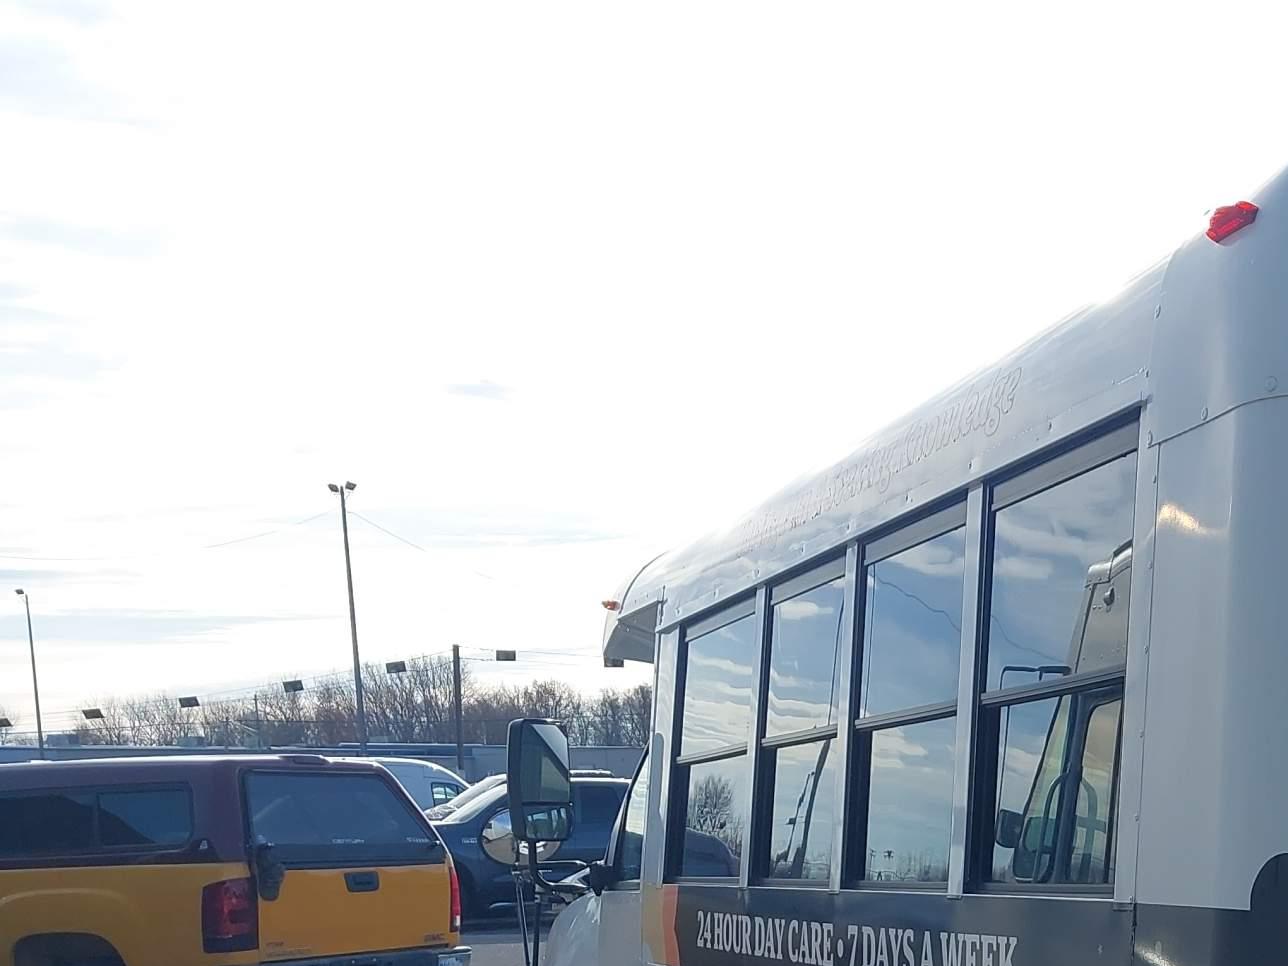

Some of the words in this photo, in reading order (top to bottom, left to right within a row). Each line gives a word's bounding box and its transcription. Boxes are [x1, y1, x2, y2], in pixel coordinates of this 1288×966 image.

[697, 910, 712, 948] 24
[713, 912, 752, 955] HOUR
[753, 915, 786, 960] DAY
